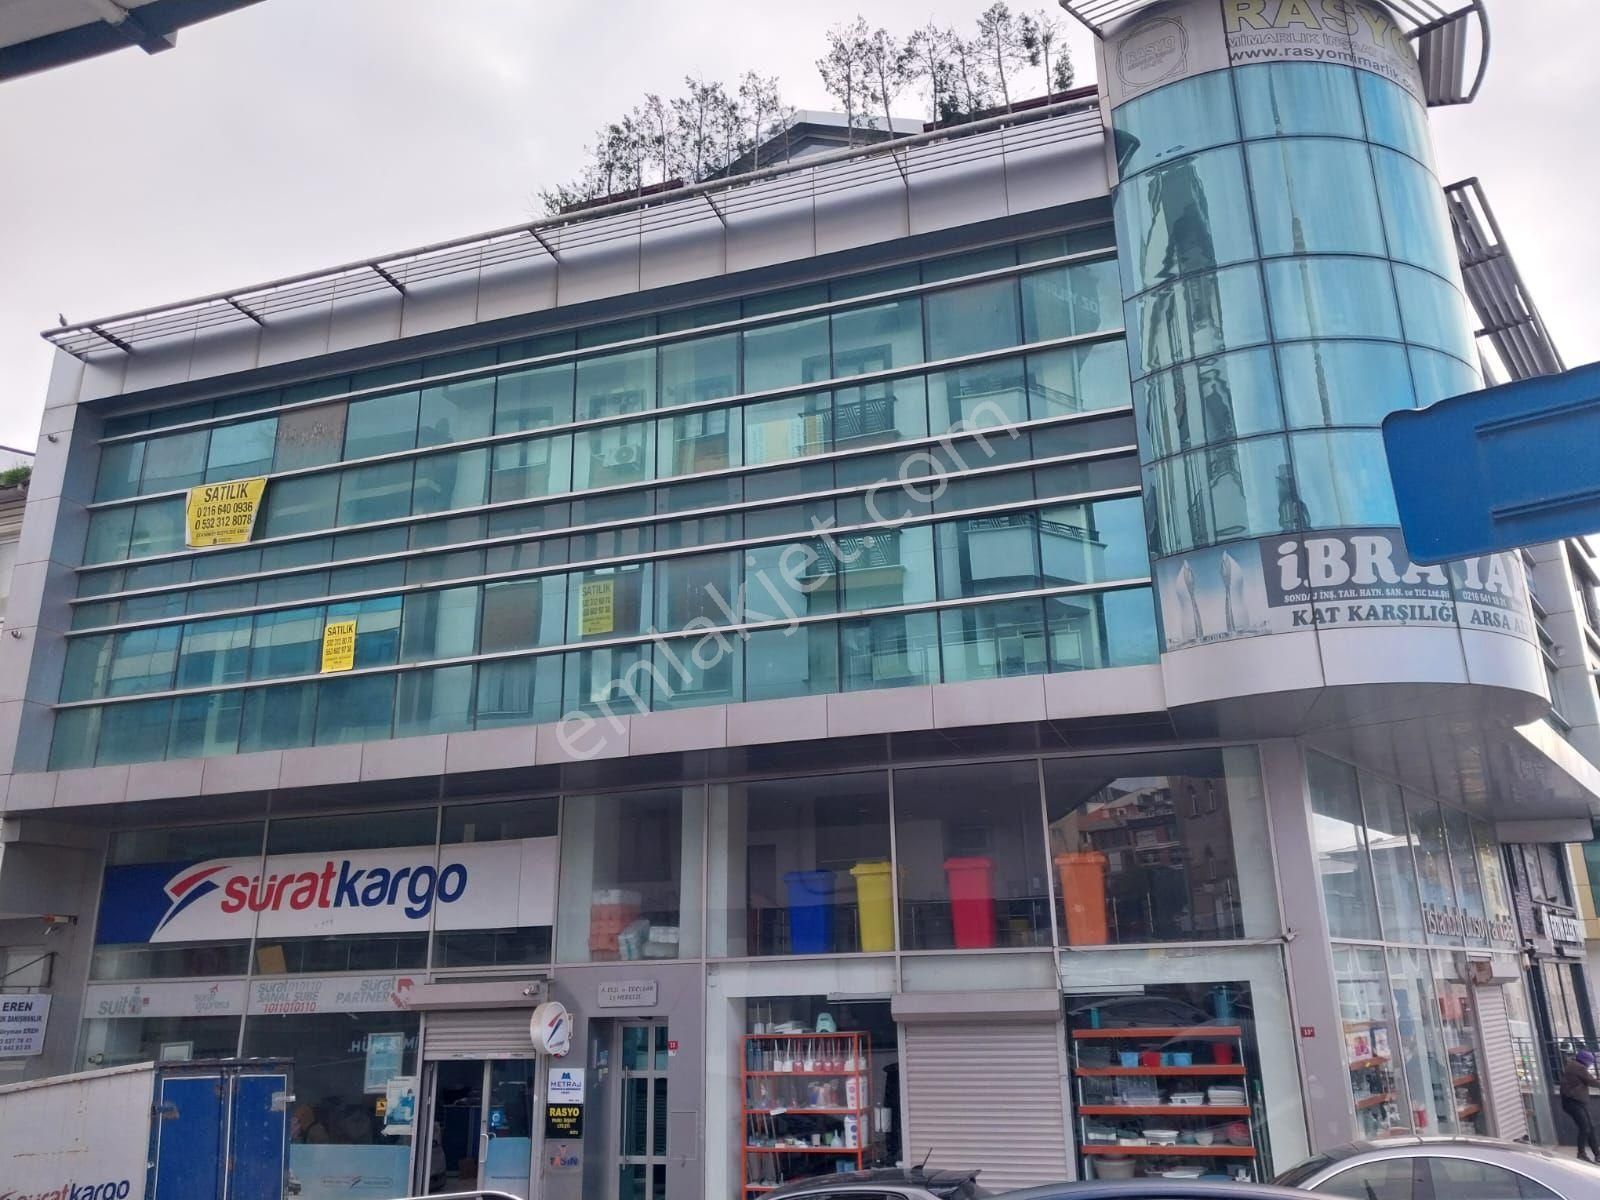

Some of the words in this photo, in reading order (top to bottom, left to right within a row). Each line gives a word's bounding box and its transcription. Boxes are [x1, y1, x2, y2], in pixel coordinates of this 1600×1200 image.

[204, 482, 249, 503] SATILIK
[197, 507, 202, 518] 0
[203, 505, 216, 517] 216
[217, 503, 232, 515] 640
[195, 519, 201, 530] 0
[201, 518, 215, 530] 532
[216, 516, 231, 528] 312
[583, 583, 611, 596] SATILIK
[1292, 606, 1341, 627] KAT
[1470, 609, 1511, 631] ARSA
[327, 623, 354, 637] SATILIK
[220, 860, 468, 920] süratkargo
[2, 1002, 33, 1012] EREN
[549, 1107, 580, 1117] RASYO
